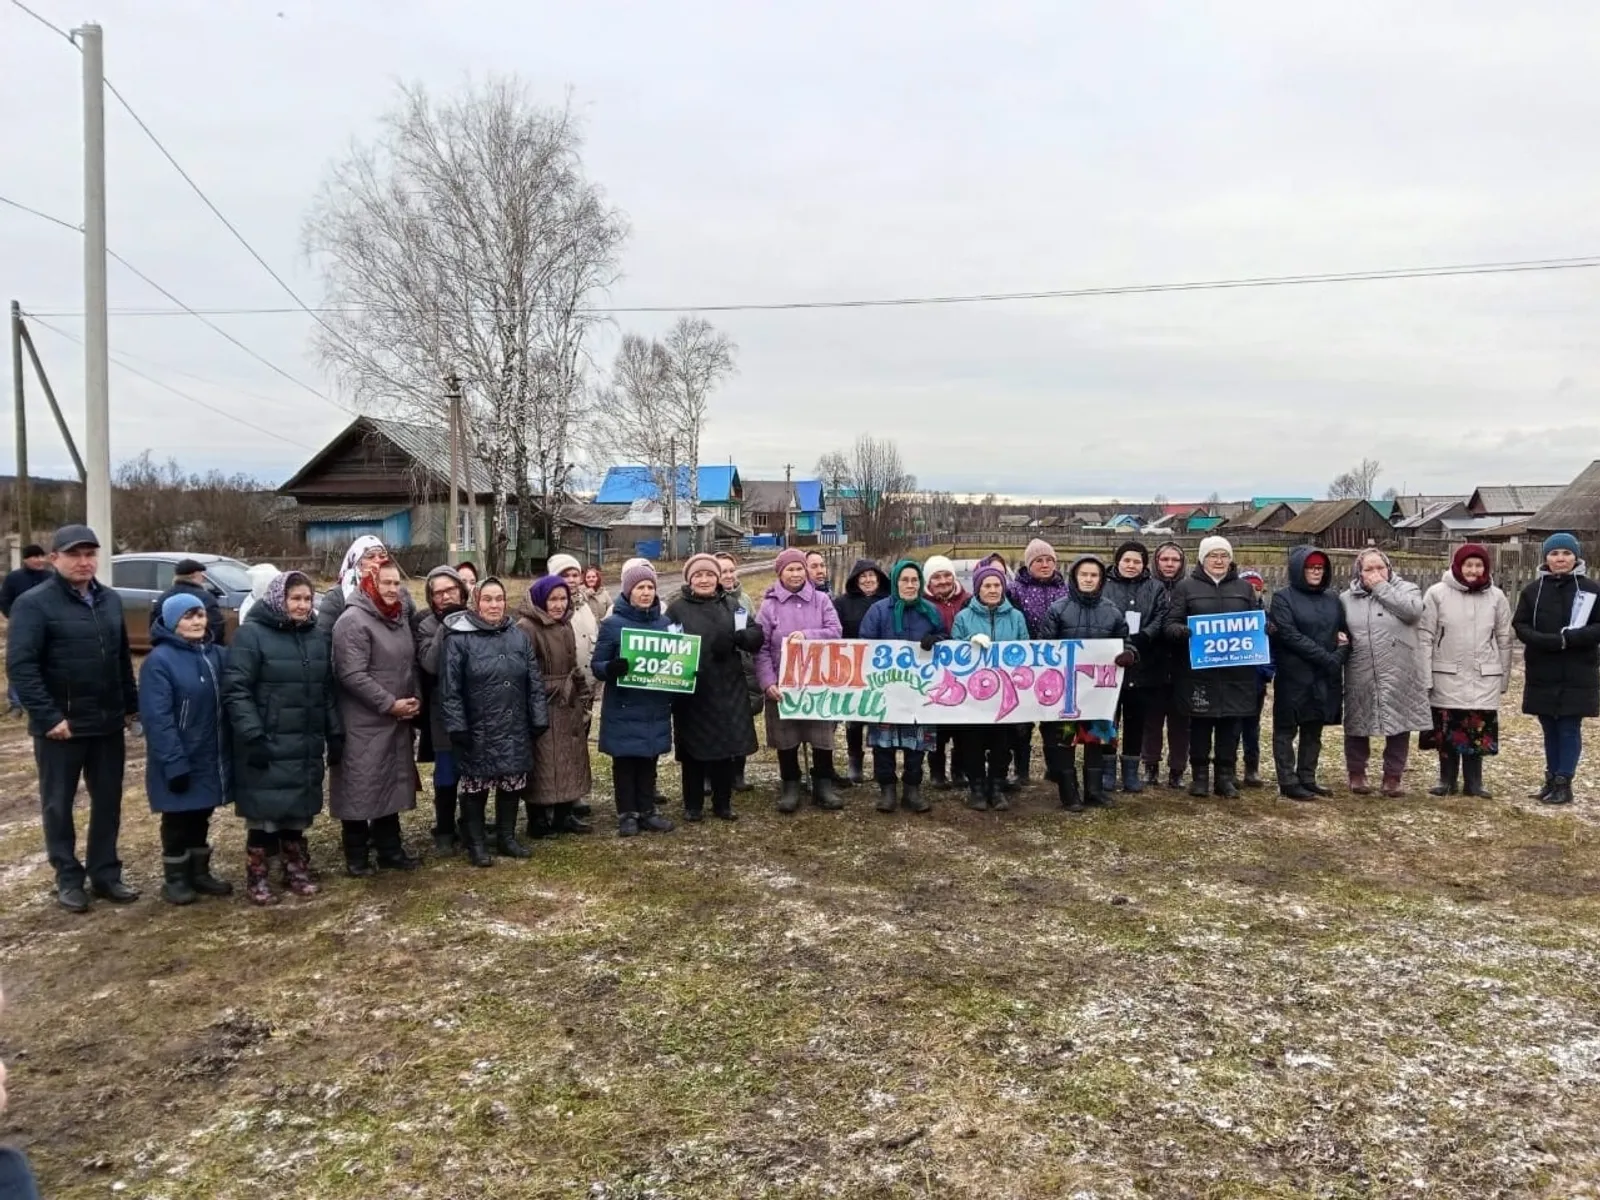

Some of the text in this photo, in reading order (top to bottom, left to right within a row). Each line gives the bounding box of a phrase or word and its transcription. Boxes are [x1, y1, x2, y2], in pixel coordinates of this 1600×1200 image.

[1195, 617, 1259, 636] ППМИ
[629, 635, 692, 656] ППМИ
[1203, 636, 1254, 654] 2026
[633, 656, 683, 676] 2026
[780, 642, 869, 690] МЫ
[872, 644, 921, 669] за
